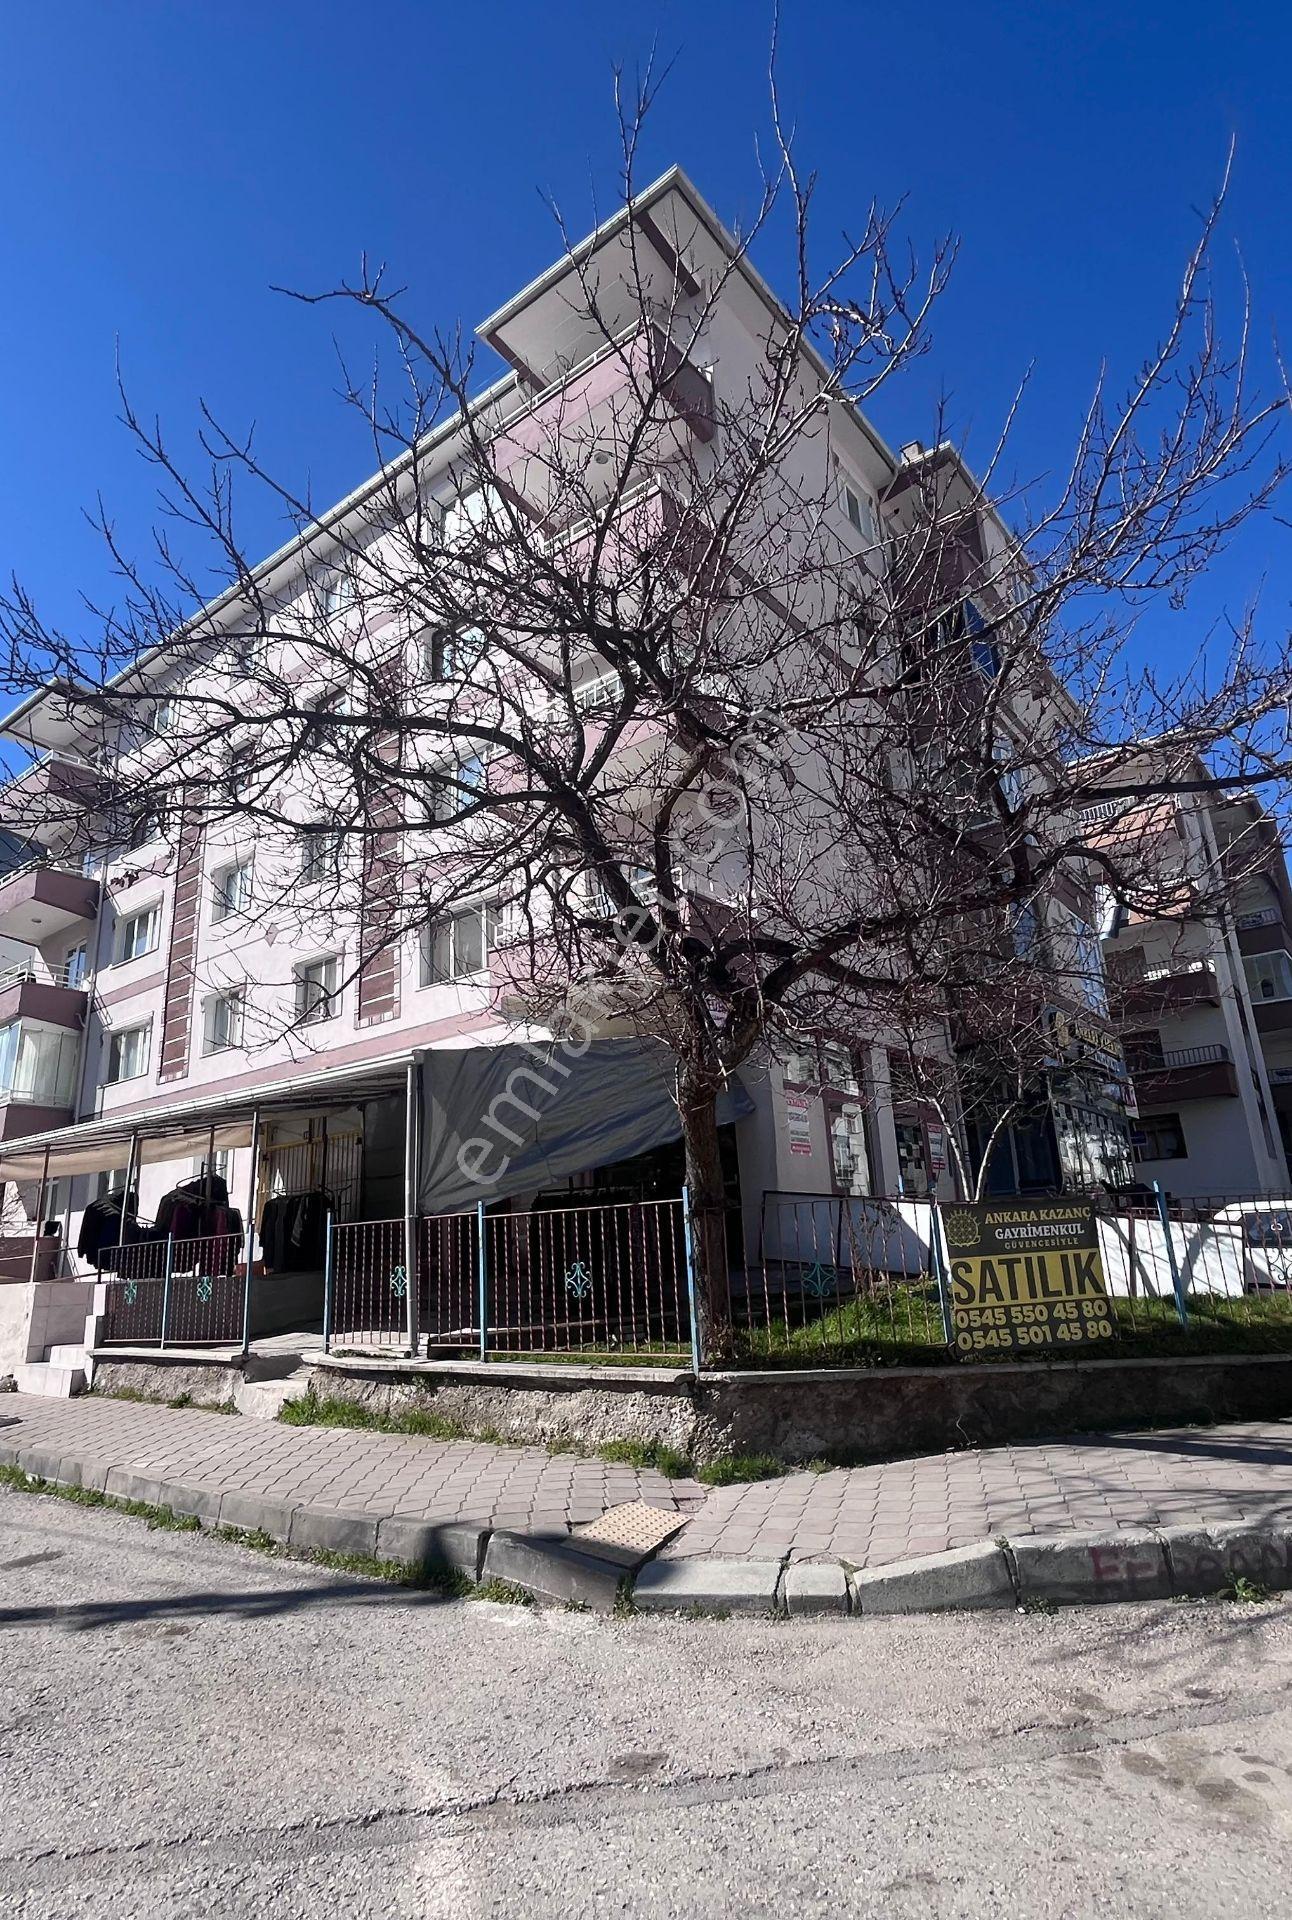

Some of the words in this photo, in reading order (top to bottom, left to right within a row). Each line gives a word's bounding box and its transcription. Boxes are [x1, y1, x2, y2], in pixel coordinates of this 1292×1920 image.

[984, 1210, 1039, 1225] ANKARA
[1038, 1206, 1092, 1221] KAZANÇ
[994, 1223, 1085, 1240] GAYRİMENKUL
[1004, 1237, 1079, 1250] GÜVENCESİYLE
[951, 1252, 1104, 1305] SATILIK
[956, 1308, 1007, 1329] 0545
[1010, 1304, 1049, 1324] 550
[1052, 1302, 1079, 1320] 45
[1082, 1299, 1108, 1318] 80
[957, 1328, 1013, 1350] 0545
[1016, 1325, 1052, 1346] 501
[1056, 1322, 1083, 1341] 45
[1086, 1319, 1113, 1339] 80
